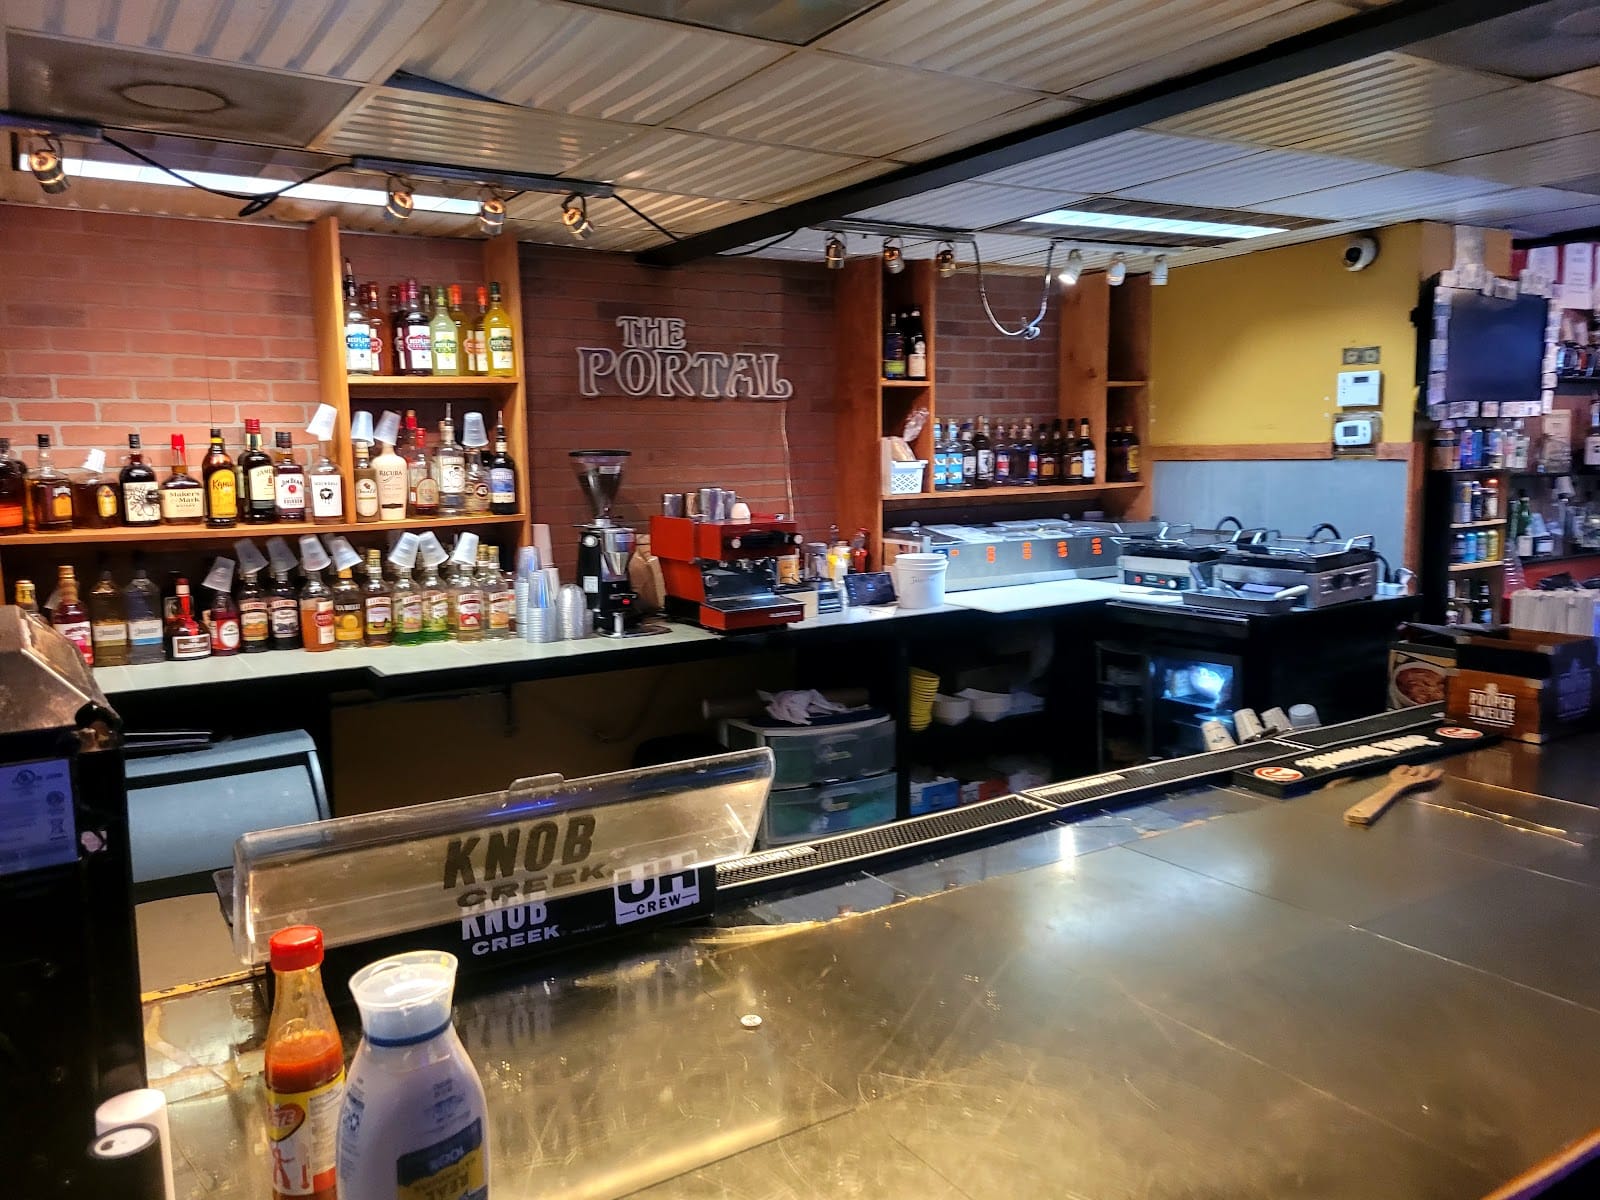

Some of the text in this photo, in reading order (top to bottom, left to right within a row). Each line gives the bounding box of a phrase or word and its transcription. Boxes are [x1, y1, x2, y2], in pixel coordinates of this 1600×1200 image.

[616, 316, 686, 349] THE
[576, 347, 793, 398] PORTAL
[1468, 704, 1516, 723] TWELVE
[1469, 692, 1516, 710] PROPER
[443, 814, 597, 890] KNOB
[457, 862, 611, 908] CREEK
[637, 893, 681, 915] CREW
[472, 924, 561, 956] CREEK
